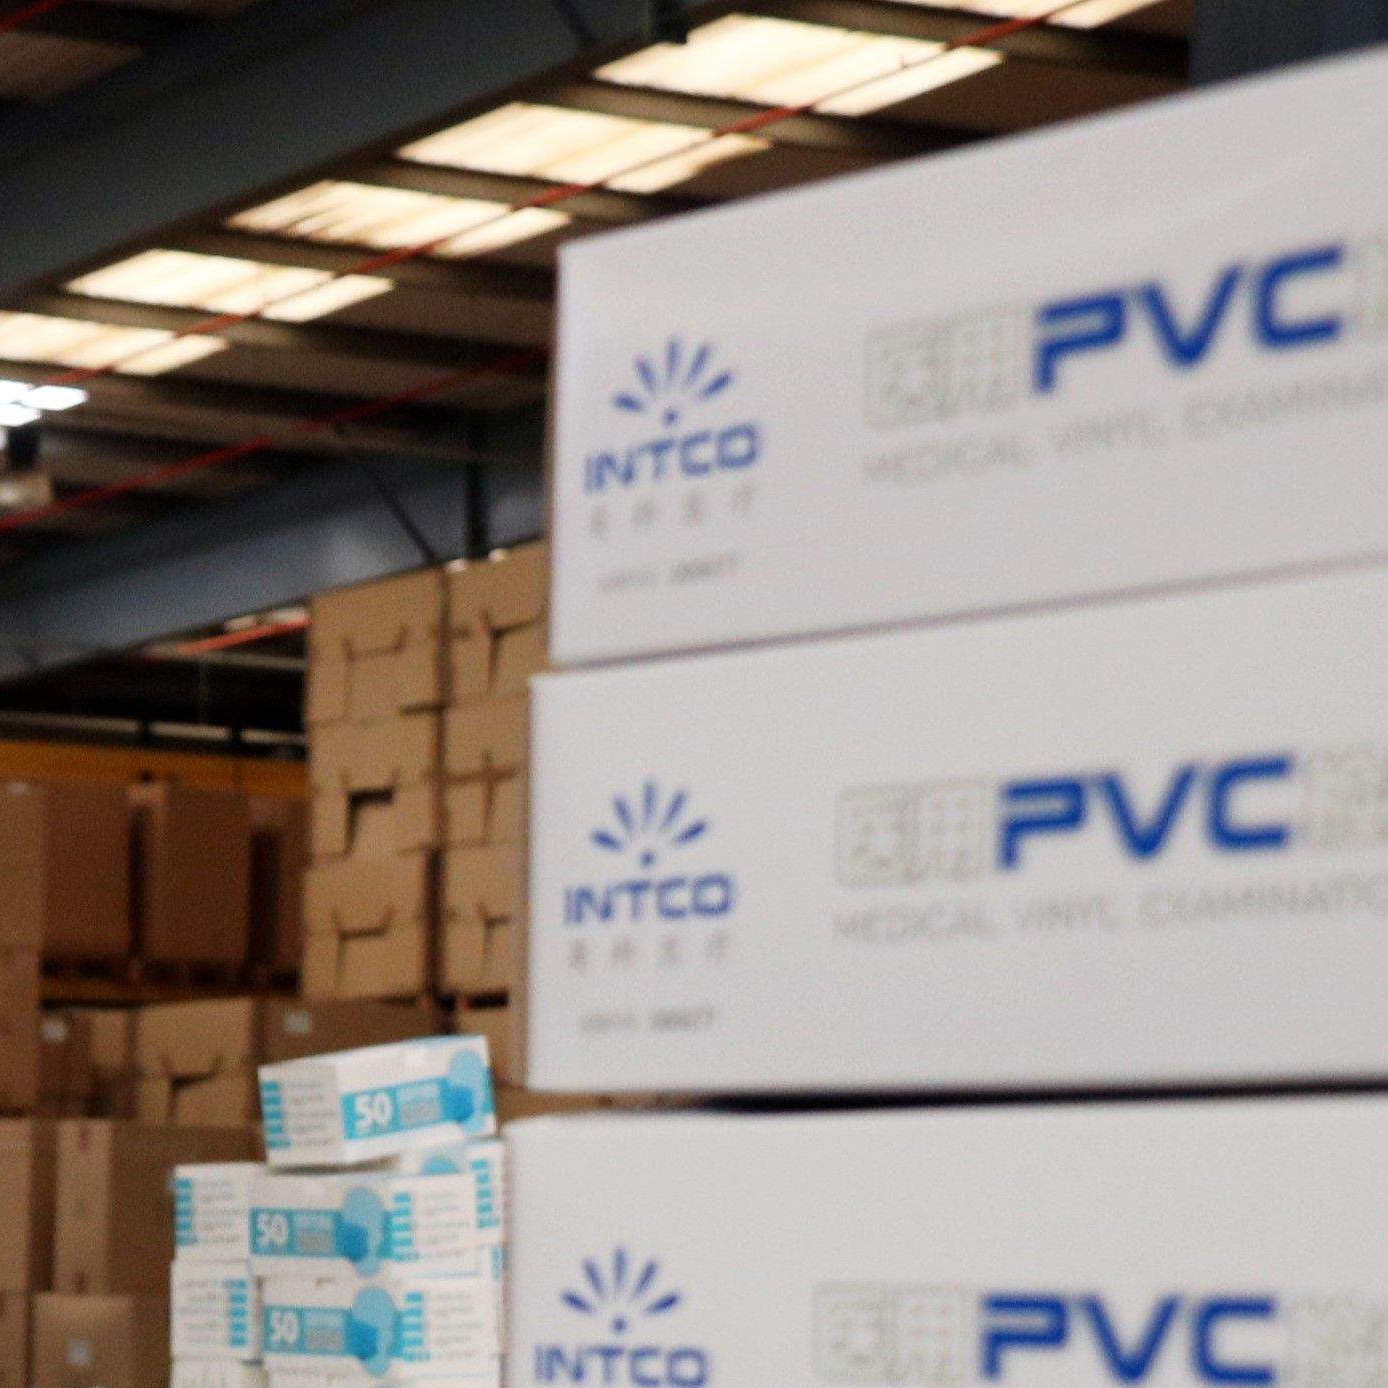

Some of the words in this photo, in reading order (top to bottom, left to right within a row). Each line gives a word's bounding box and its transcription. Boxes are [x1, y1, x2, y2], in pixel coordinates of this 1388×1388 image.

[1032, 244, 1345, 393] PVC
[585, 422, 762, 493] INTCO
[995, 755, 1293, 872] PVC
[563, 874, 736, 926] INTCO
[355, 1092, 392, 1134] 50
[256, 1212, 291, 1250] 50
[267, 1309, 302, 1346] 50
[977, 1292, 1279, 1388] PVC
